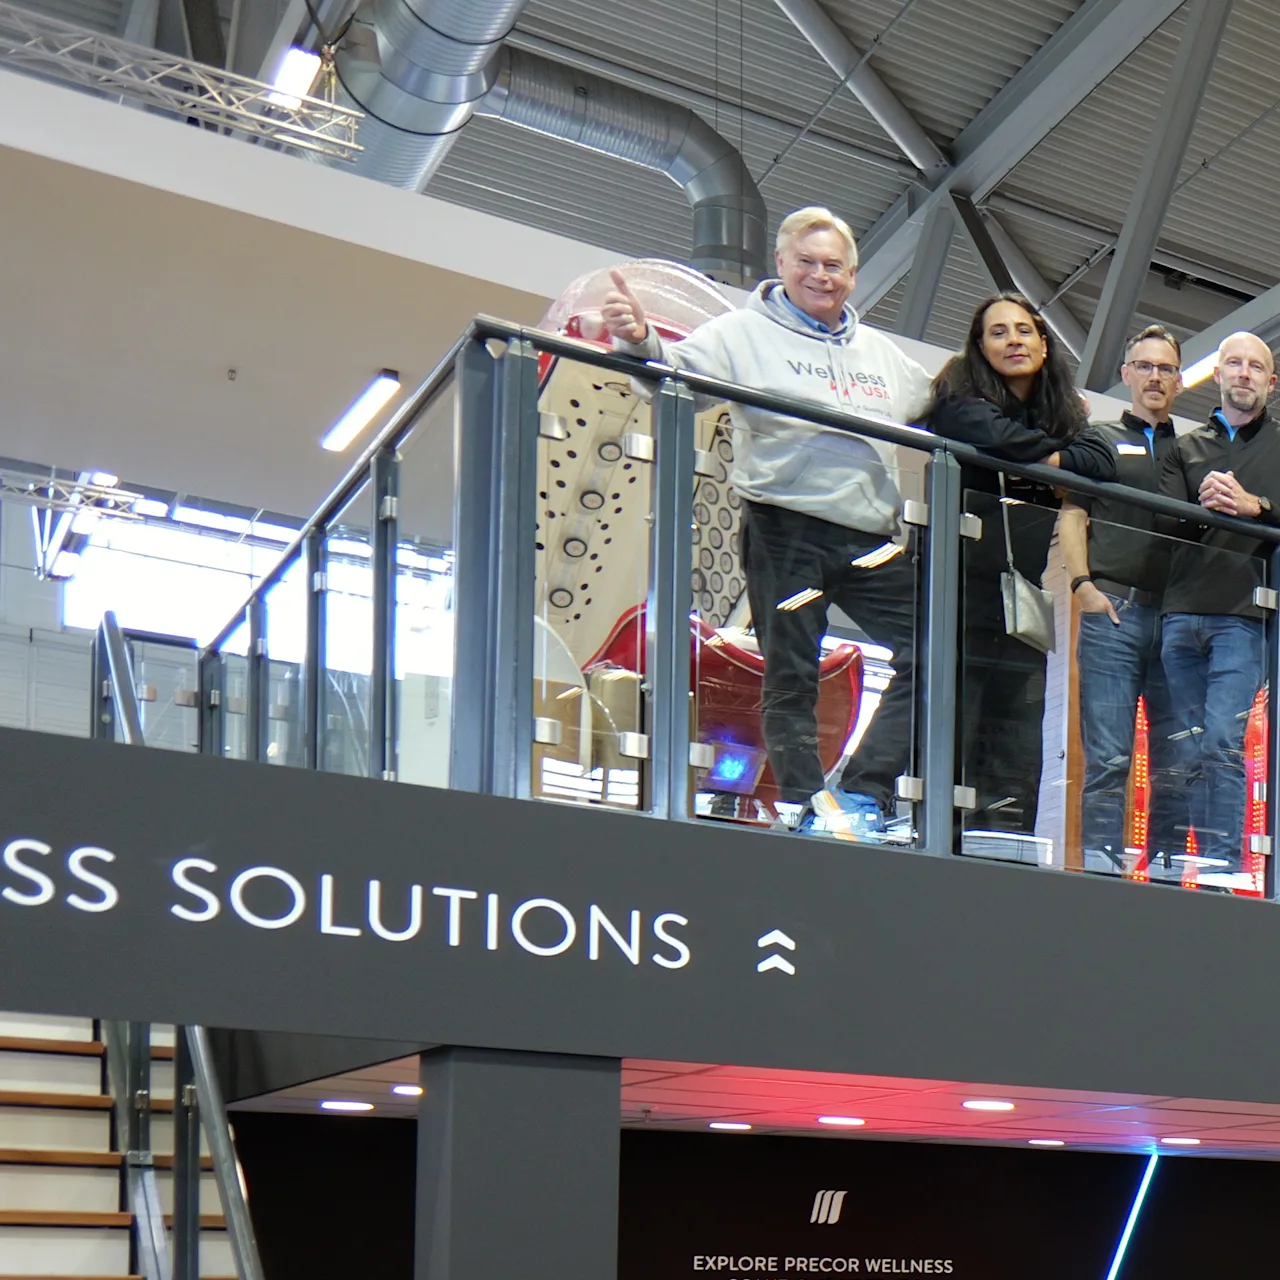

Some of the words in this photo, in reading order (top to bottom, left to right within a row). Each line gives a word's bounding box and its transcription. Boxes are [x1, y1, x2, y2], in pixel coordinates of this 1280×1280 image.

[1, 838, 120, 912] SS
[170, 857, 692, 970] SOLUTIONS
[693, 1255, 778, 1271] EXPLORE
[784, 1257, 860, 1272] PRECOR
[865, 1258, 954, 1273] WELLNESS
